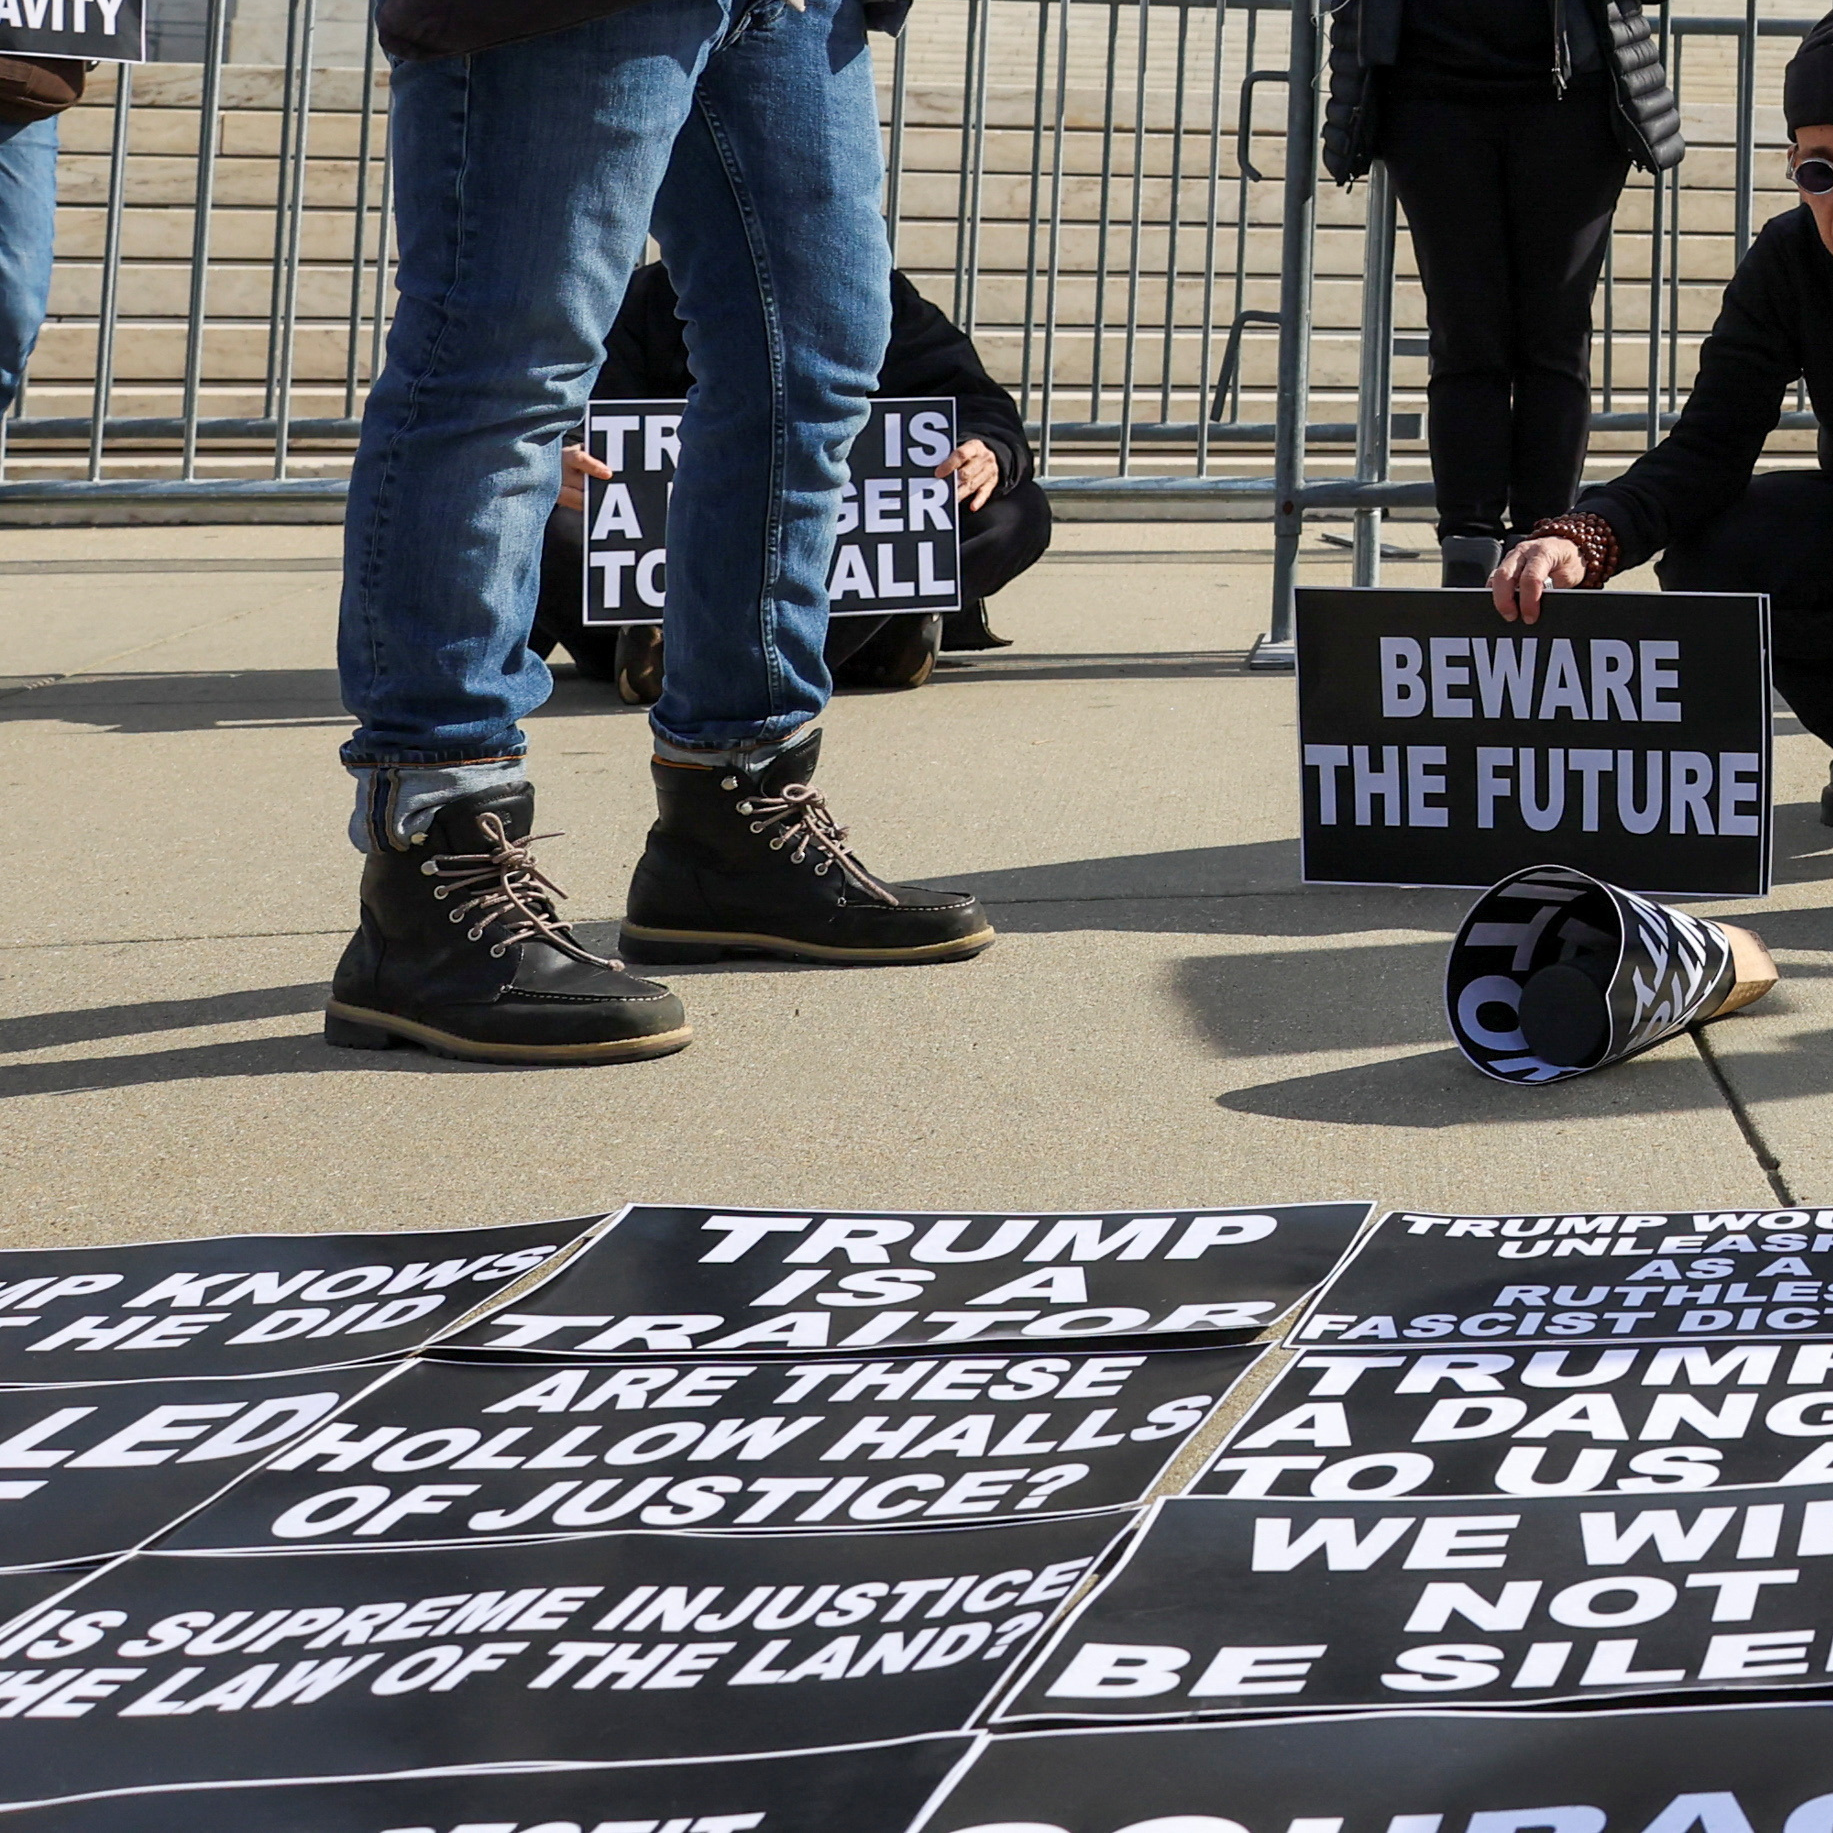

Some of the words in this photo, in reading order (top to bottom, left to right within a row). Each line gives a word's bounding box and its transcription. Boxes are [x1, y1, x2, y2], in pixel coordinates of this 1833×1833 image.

[1379, 636, 1682, 722] BEWARE
[1304, 744, 1449, 827] THE
[1476, 746, 1759, 837] FUTURE
[699, 1215, 1278, 1266] TRUMP
[1401, 1212, 1650, 1240] TRUMP
[122, 1244, 558, 1308] KNOWS
[749, 1267, 938, 1308] IS
[965, 1265, 1089, 1306] A
[1626, 1257, 1734, 1282] AS
[1755, 1255, 1813, 1280] A
[224, 1294, 446, 1345] DID
[483, 1301, 1279, 1350] TRAITOR
[1300, 1310, 1658, 1342] FASCIST
[482, 1365, 757, 1414] ARE
[775, 1355, 1147, 1406] THESE
[265, 1415, 823, 1474] HOLLOW
[819, 1394, 1214, 1462] HALLS
[1232, 1401, 1351, 1451] A
[271, 1483, 482, 1539] OF
[469, 1463, 1091, 1531] JUSTICE?
[1251, 1514, 1521, 1572] WE
[118, 1584, 605, 1657] SUPREME
[592, 1558, 1092, 1634] INJUSTICE
[1403, 1569, 1798, 1631] NOT
[116, 1654, 385, 1718] LAW
[370, 1643, 532, 1695] OF
[527, 1639, 713, 1692] THE
[726, 1609, 1047, 1686] LAND?
[1044, 1644, 1327, 1698] BE
